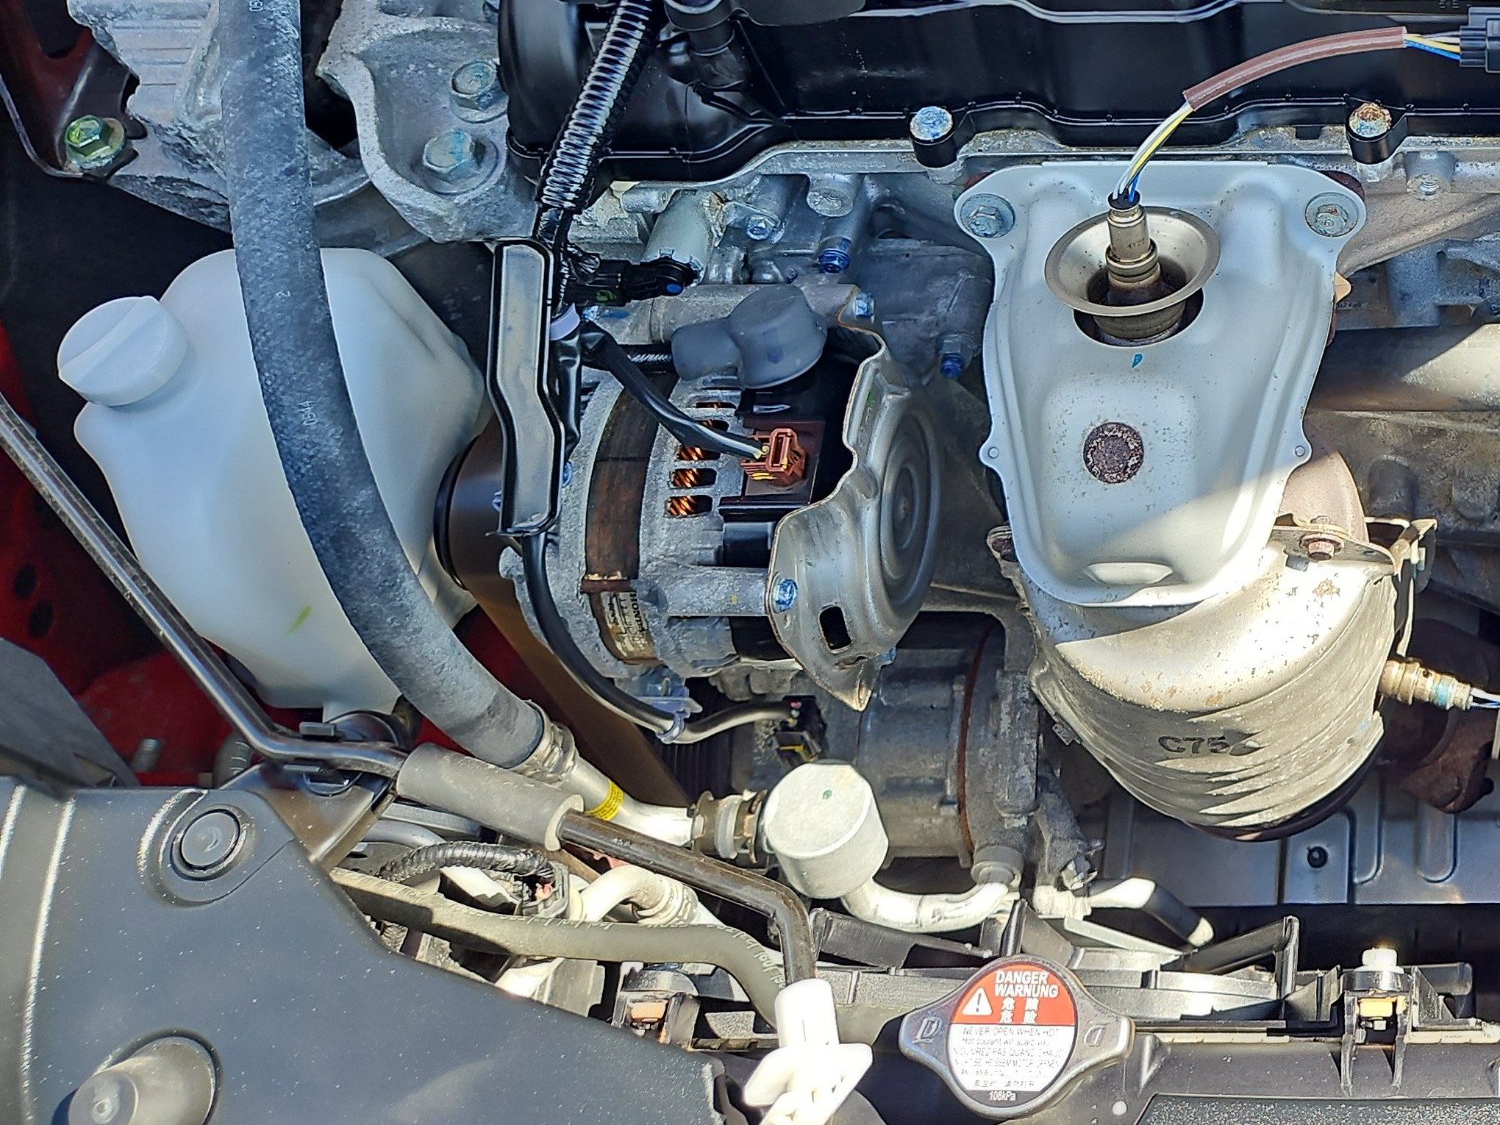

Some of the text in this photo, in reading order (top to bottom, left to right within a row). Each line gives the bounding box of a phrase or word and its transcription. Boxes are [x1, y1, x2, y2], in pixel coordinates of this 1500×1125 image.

[1157, 734, 1230, 755] C75
[996, 970, 1049, 985] DANGER
[994, 983, 1060, 999] WARNUNG
[962, 1026, 991, 1037] NEVER
[992, 1026, 1015, 1037] OPEN
[1016, 1027, 1041, 1037] WHEN
[988, 1090, 1017, 1102] 108kPa
